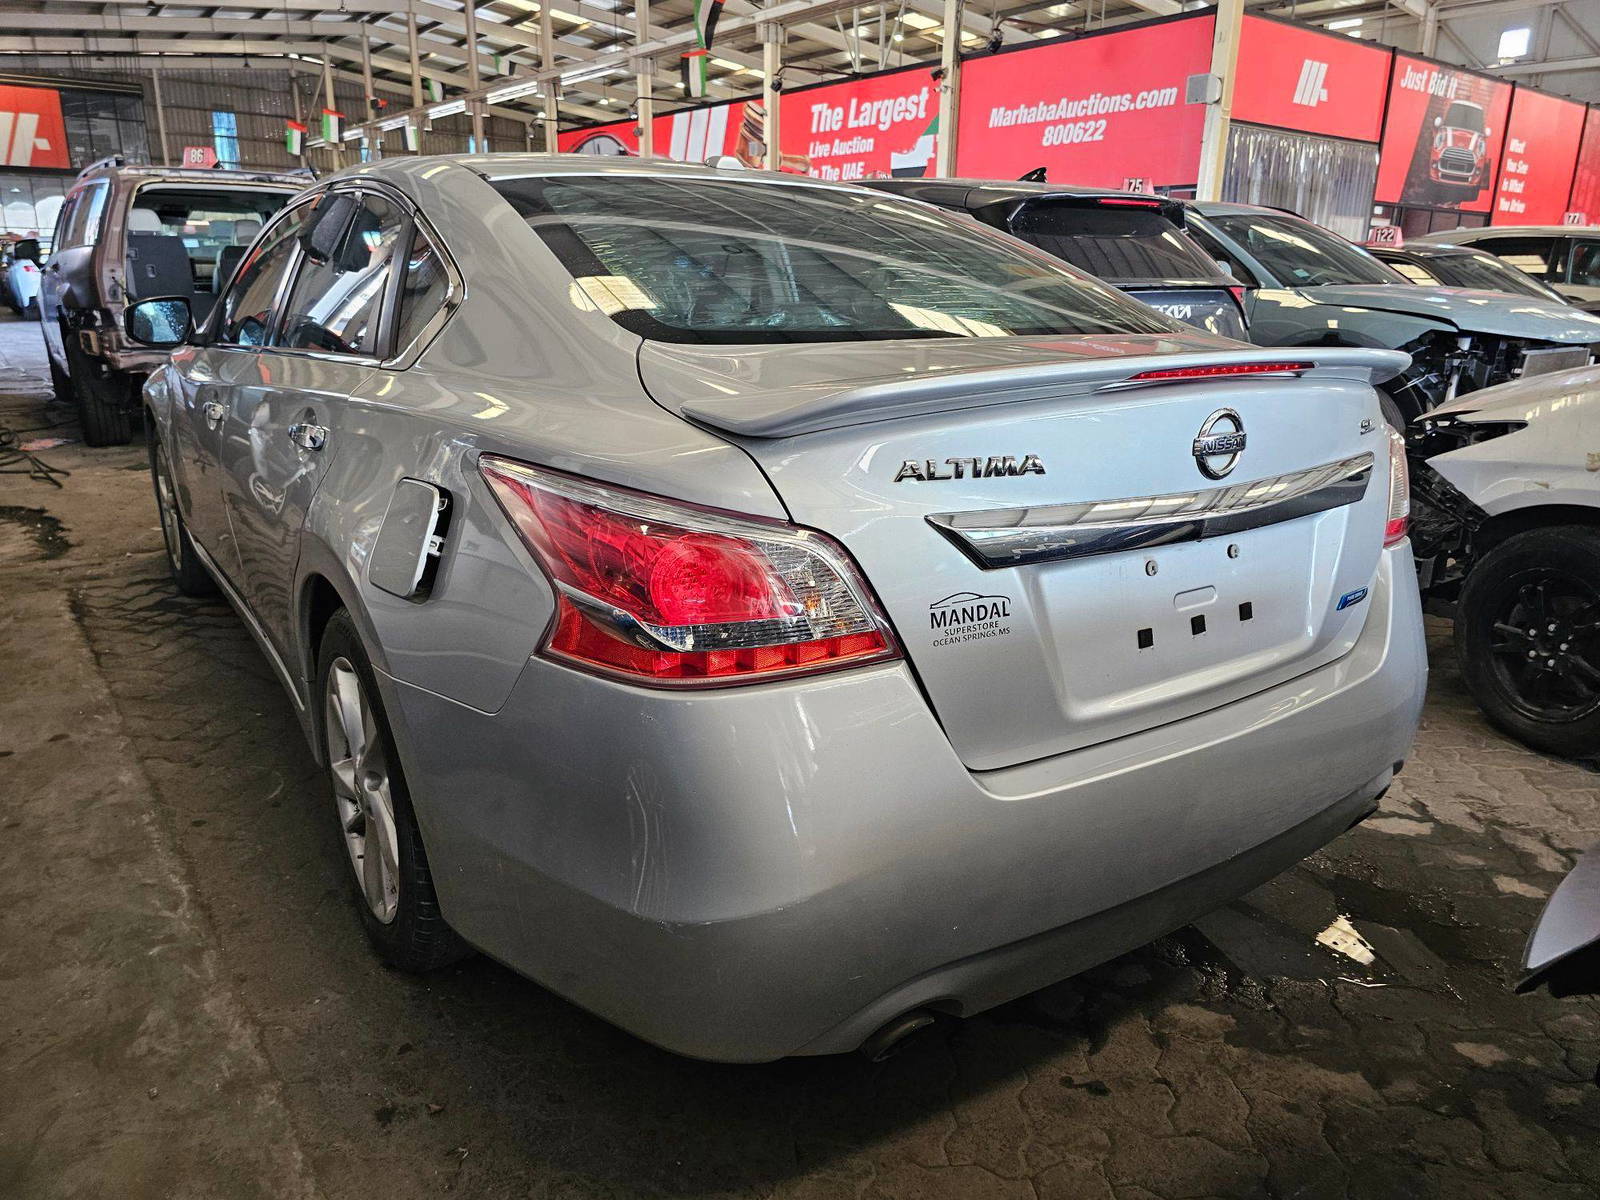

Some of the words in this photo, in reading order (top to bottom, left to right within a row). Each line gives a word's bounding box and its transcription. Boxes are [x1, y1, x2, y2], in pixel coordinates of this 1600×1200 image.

[1400, 65, 1428, 93] Just
[1427, 71, 1448, 97] Bid
[1446, 77, 1457, 99] It
[811, 102, 844, 133] The
[848, 87, 929, 131] Largest
[988, 87, 1178, 128] MarhabaAuctions.com
[1042, 120, 1107, 147] 800622
[190, 148, 204, 163] 86
[809, 142, 831, 158] Live
[831, 137, 874, 157] Auction
[820, 165, 841, 180] The
[841, 161, 865, 180] UAE
[1128, 179, 1143, 192] 75
[1376, 229, 1395, 242] 122
[1203, 435, 1243, 452] NISSAN
[894, 454, 1046, 482] ALTIMA
[930, 600, 1011, 629] MANDAL
[932, 636, 961, 648] OCEAN
[998, 626, 1011, 636] MS
[944, 620, 999, 637] SUPERSTORE
